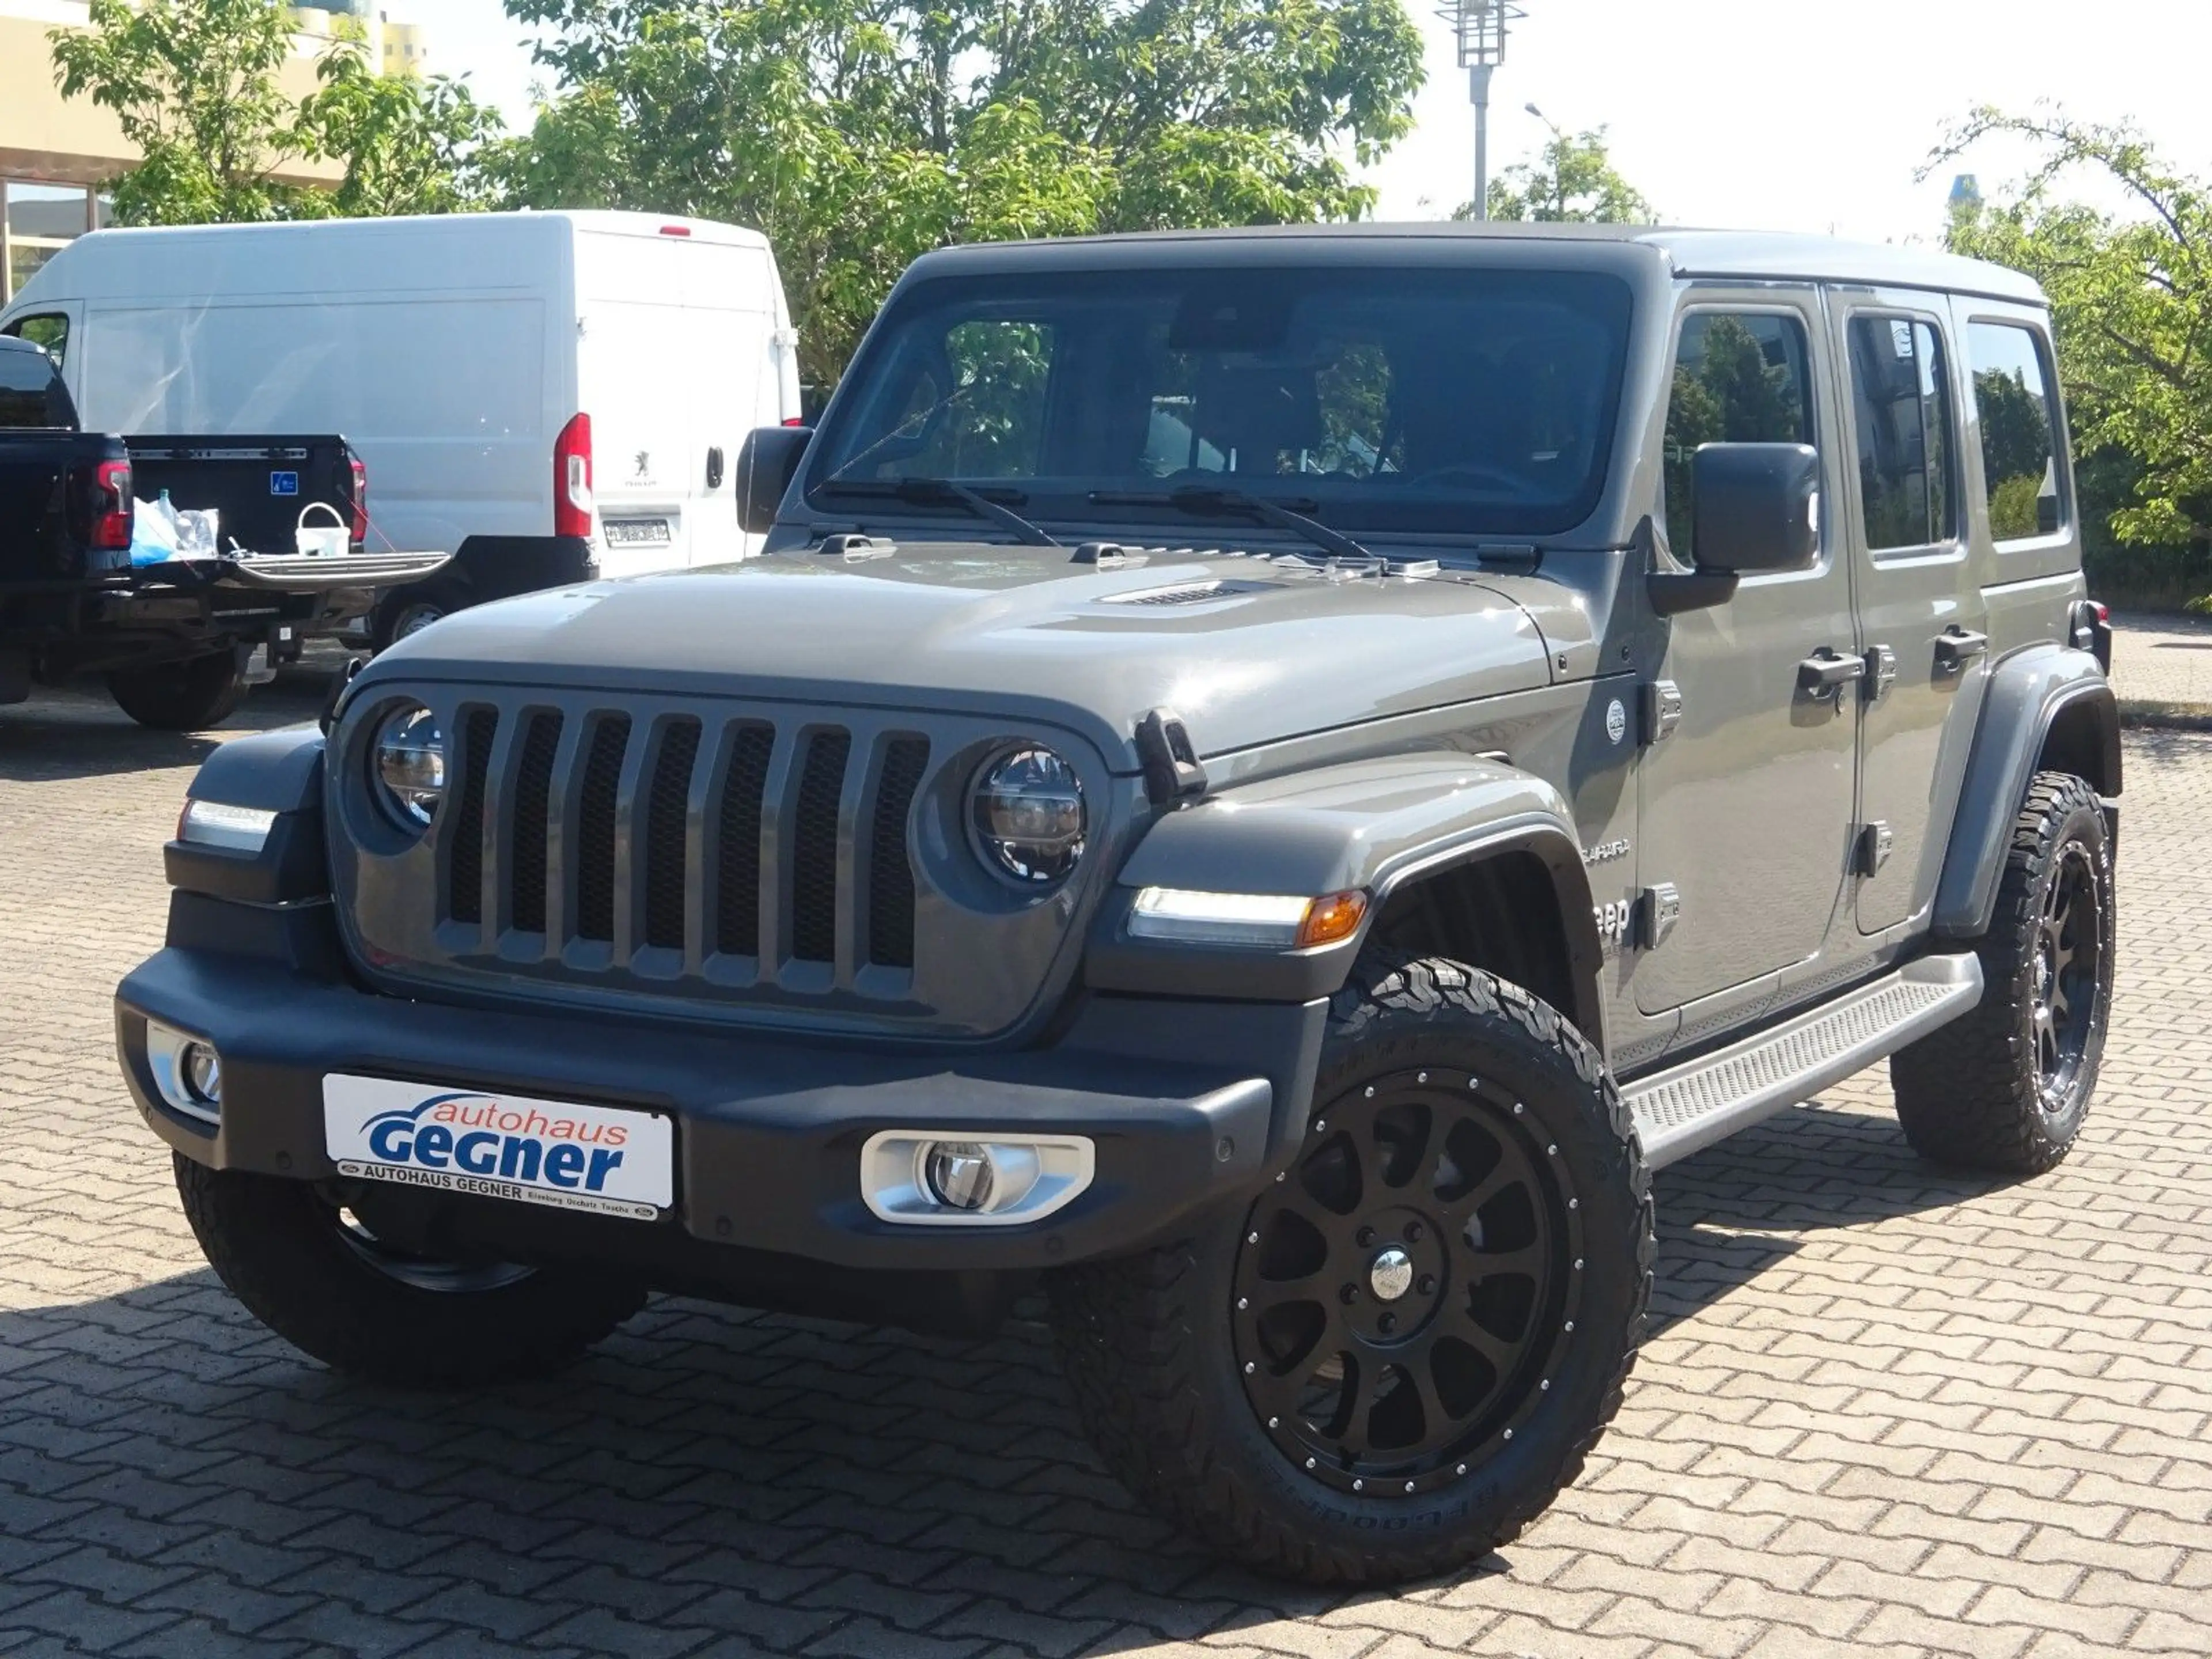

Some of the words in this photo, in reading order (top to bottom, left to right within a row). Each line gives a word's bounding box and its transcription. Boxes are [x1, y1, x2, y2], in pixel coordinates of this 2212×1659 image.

[1593, 899, 1630, 939] eep
[433, 1103, 628, 1146] autohaus
[364, 1165, 452, 1188] AUTOHAUS
[456, 1178, 522, 1199] GEGNER
